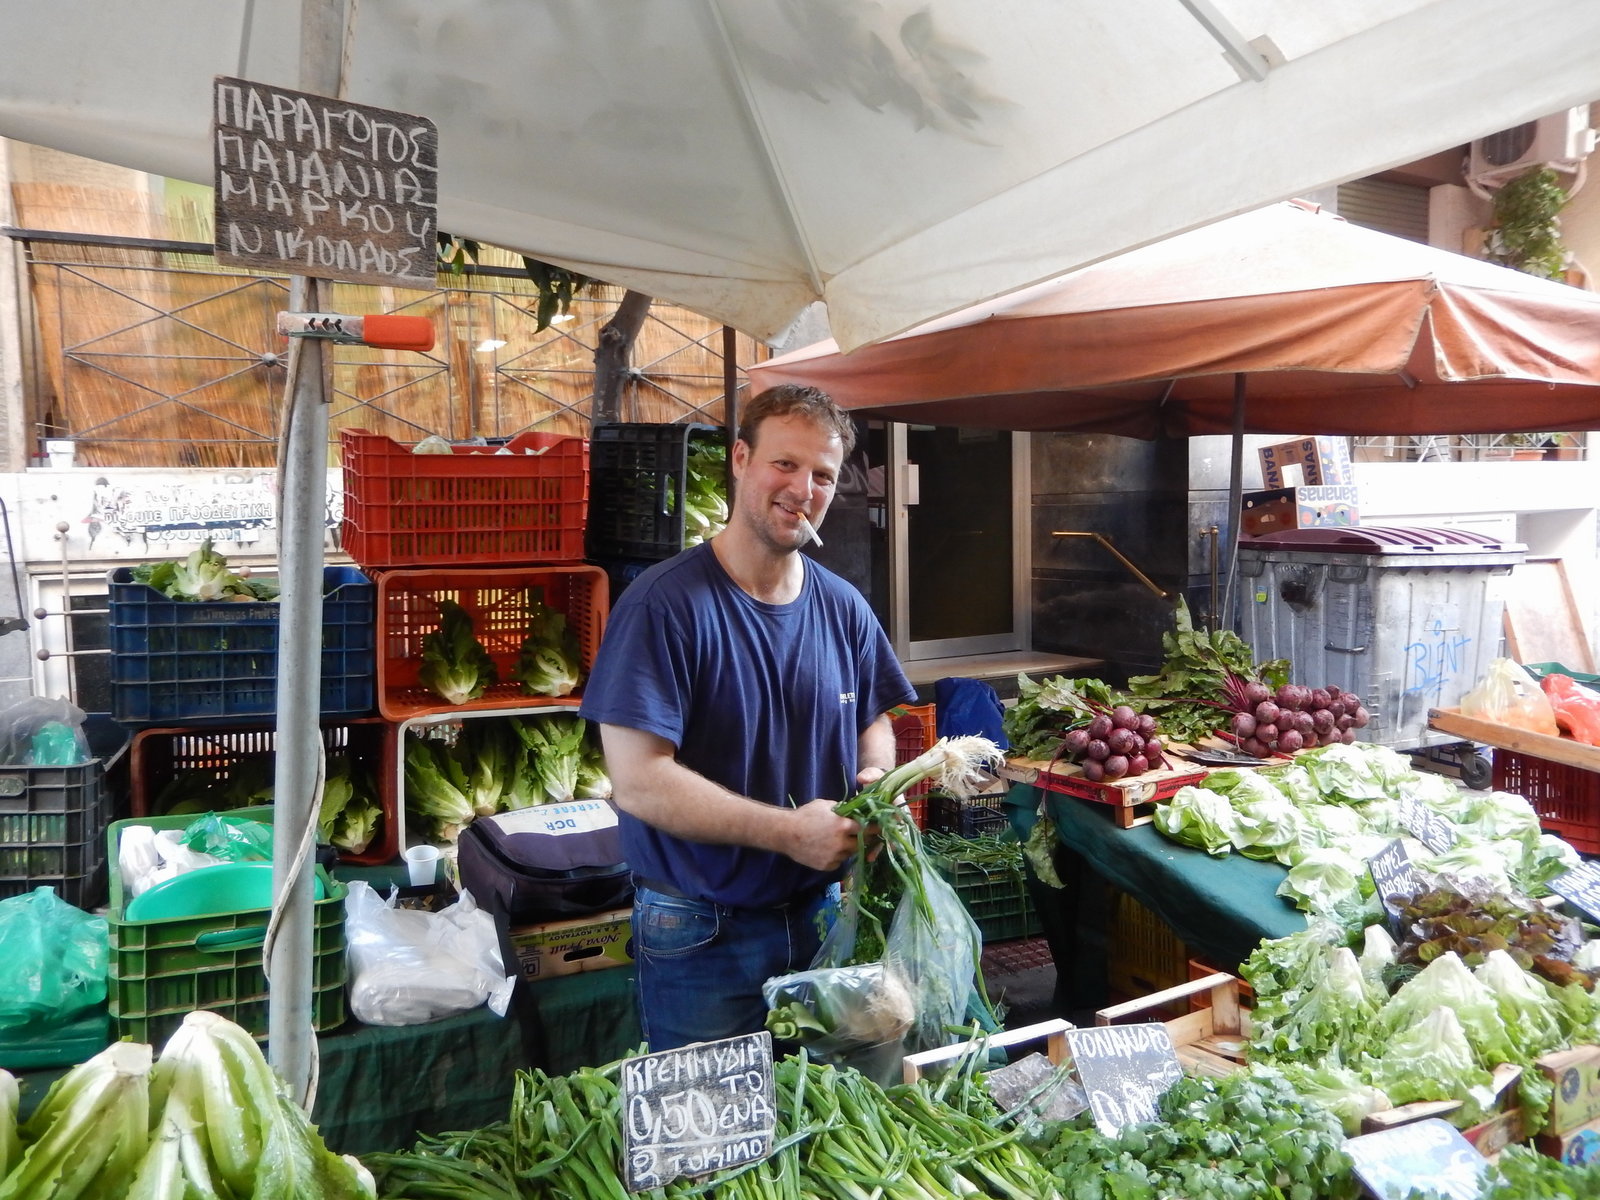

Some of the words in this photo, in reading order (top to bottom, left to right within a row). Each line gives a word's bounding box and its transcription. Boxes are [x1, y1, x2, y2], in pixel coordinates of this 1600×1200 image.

[221, 170, 430, 249] ΜΑΡΚΟΥ
[1298, 486, 1359, 505] Bananas
[544, 818, 576, 831] DCR
[719, 1070, 763, 1094] ΤΟ
[629, 1088, 718, 1144] 0,50
[719, 1094, 776, 1129] ΕΝΑ
